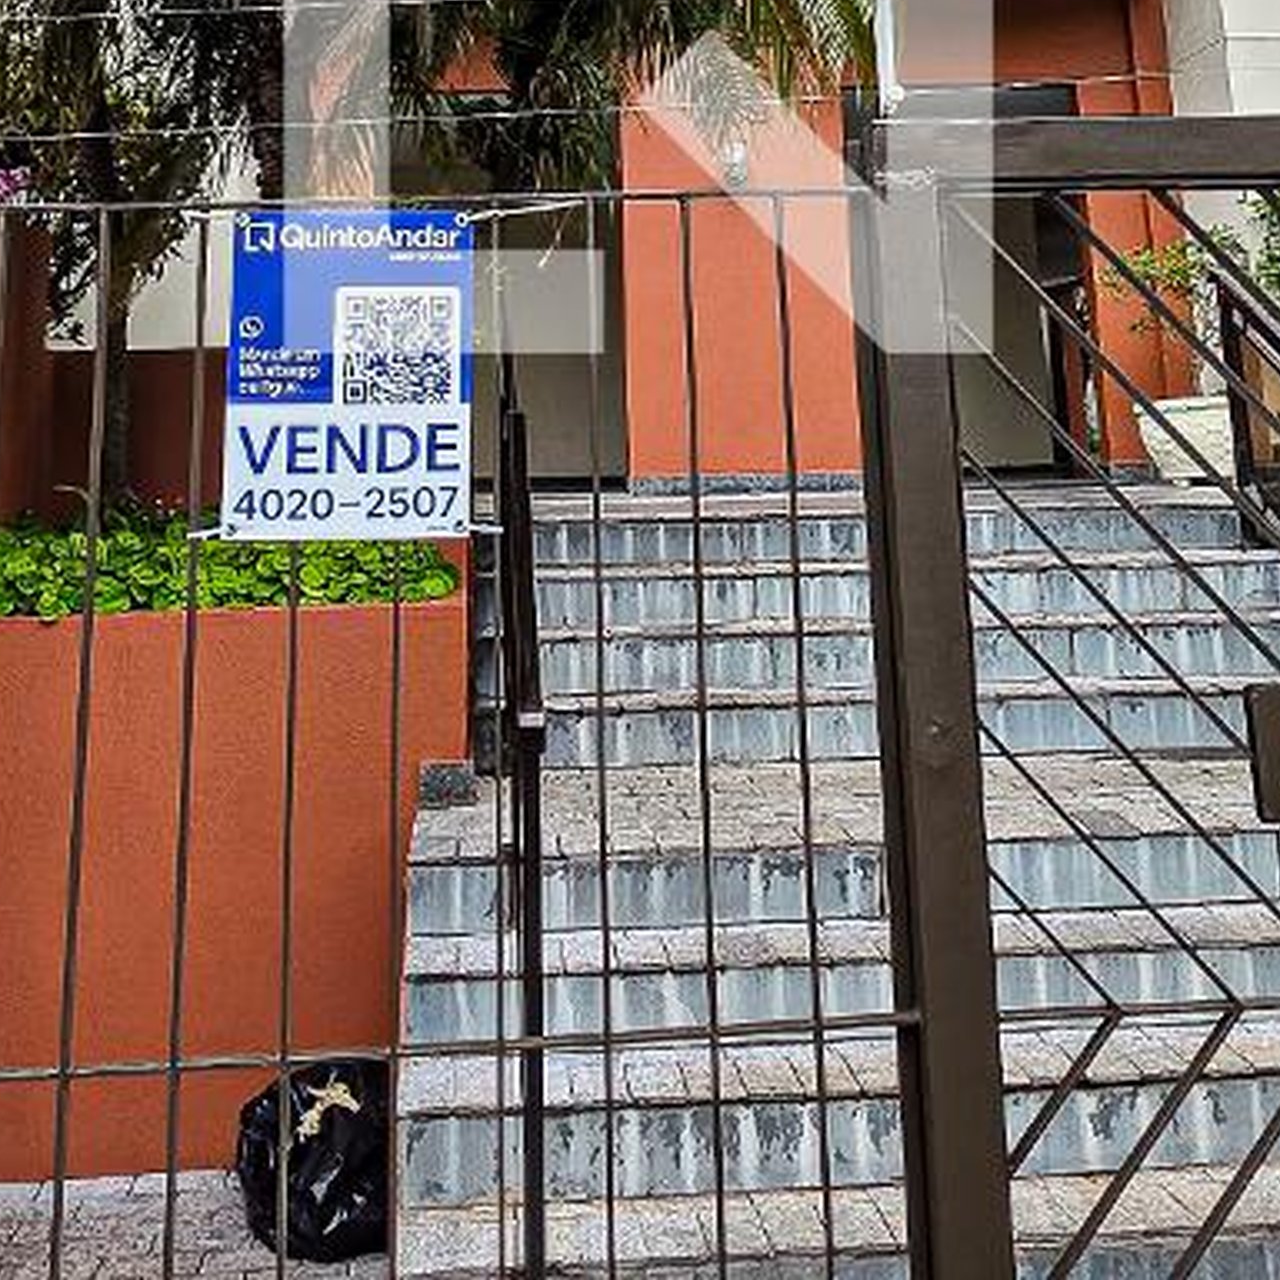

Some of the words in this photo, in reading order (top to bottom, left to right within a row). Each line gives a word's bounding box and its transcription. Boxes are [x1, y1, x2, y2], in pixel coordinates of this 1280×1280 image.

[280, 222, 461, 250] QuintoAndar
[238, 423, 460, 474] VENDE
[233, 486, 459, 520] 4020-2507
